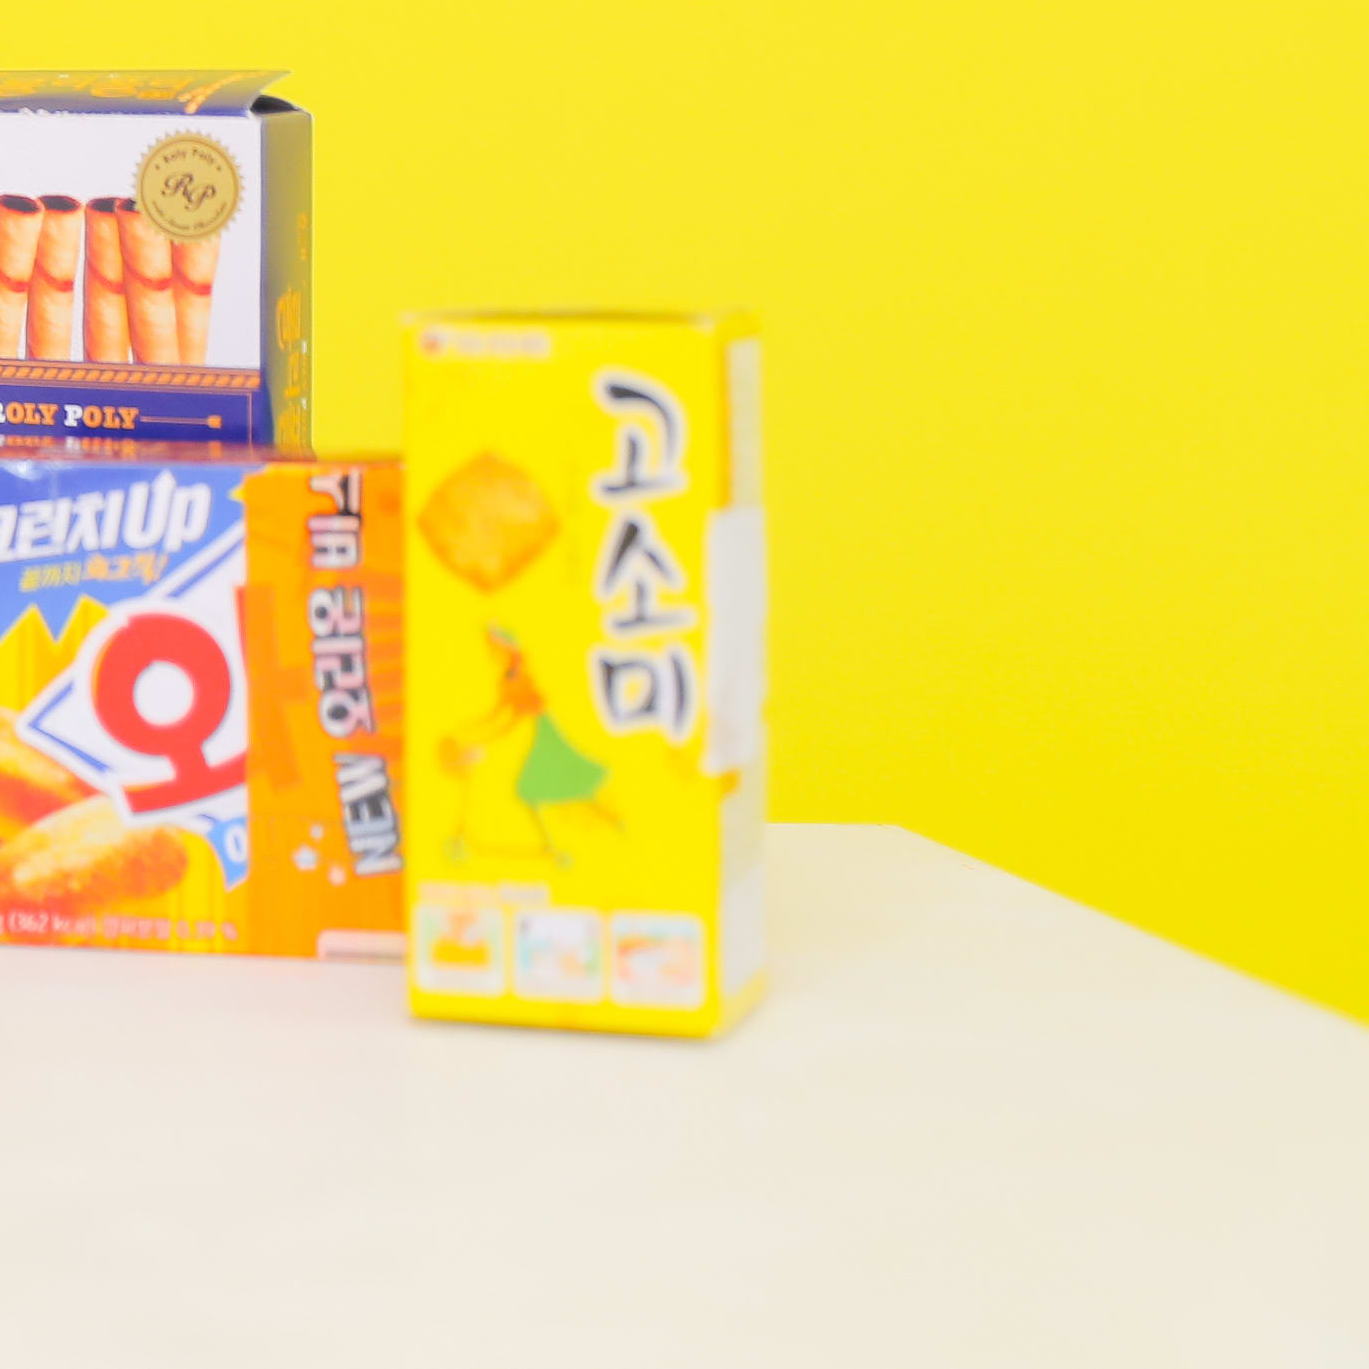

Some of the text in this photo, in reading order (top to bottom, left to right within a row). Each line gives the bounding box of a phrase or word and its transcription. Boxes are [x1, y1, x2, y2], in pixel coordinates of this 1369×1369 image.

[64, 404, 139, 429] POLY
[594, 369, 696, 737] 고소미
[308, 586, 377, 738] 오리온
[332, 752, 404, 876] NEW
